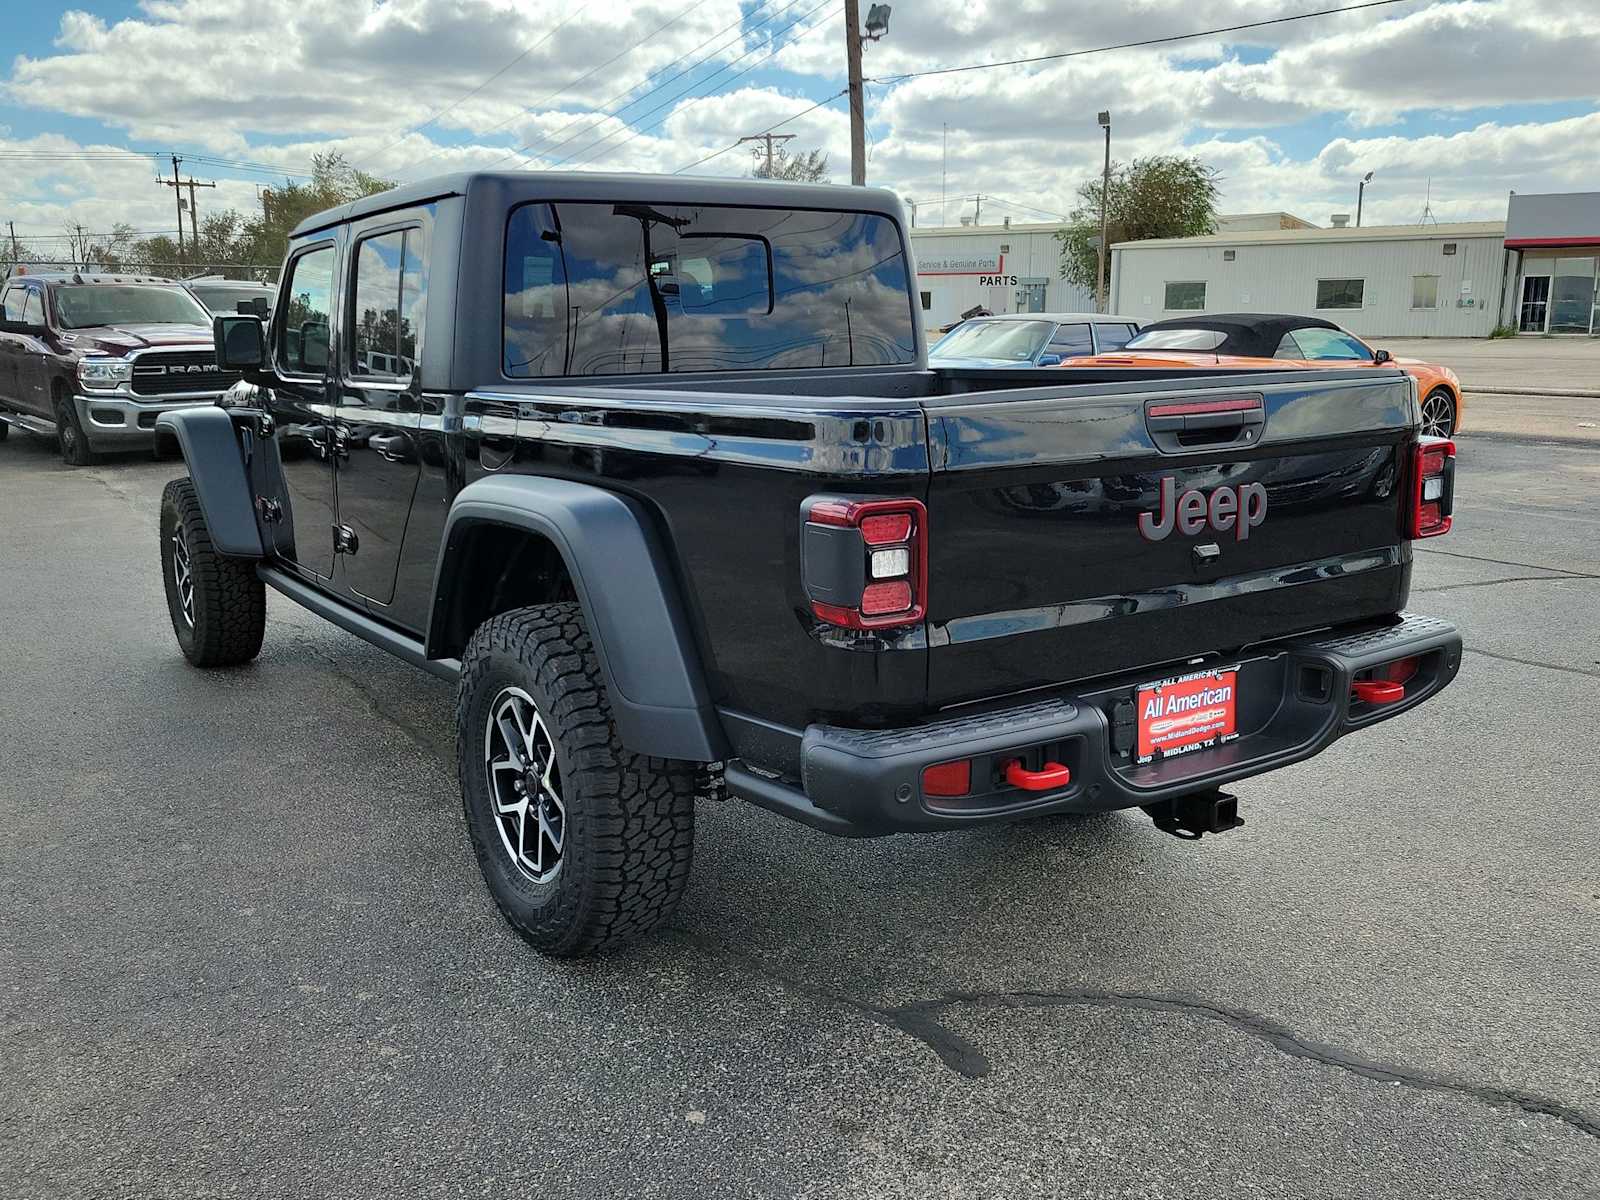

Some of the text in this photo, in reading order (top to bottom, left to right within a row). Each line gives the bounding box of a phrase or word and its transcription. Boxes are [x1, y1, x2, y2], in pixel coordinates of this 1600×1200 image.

[918, 259, 996, 269] Service & Genuine Parts
[979, 275, 1018, 286] PARTS
[169, 364, 219, 373] RAM
[1137, 476, 1268, 542] Jeep
[1162, 678, 1177, 688] ALL
[1177, 669, 1218, 683] AMERICAN
[1144, 686, 1231, 720] All American
[1150, 721, 1225, 743] www.MidlandDodge.com
[1163, 739, 1215, 758] MIDLAND, TX
[1137, 755, 1153, 764] Jeep
